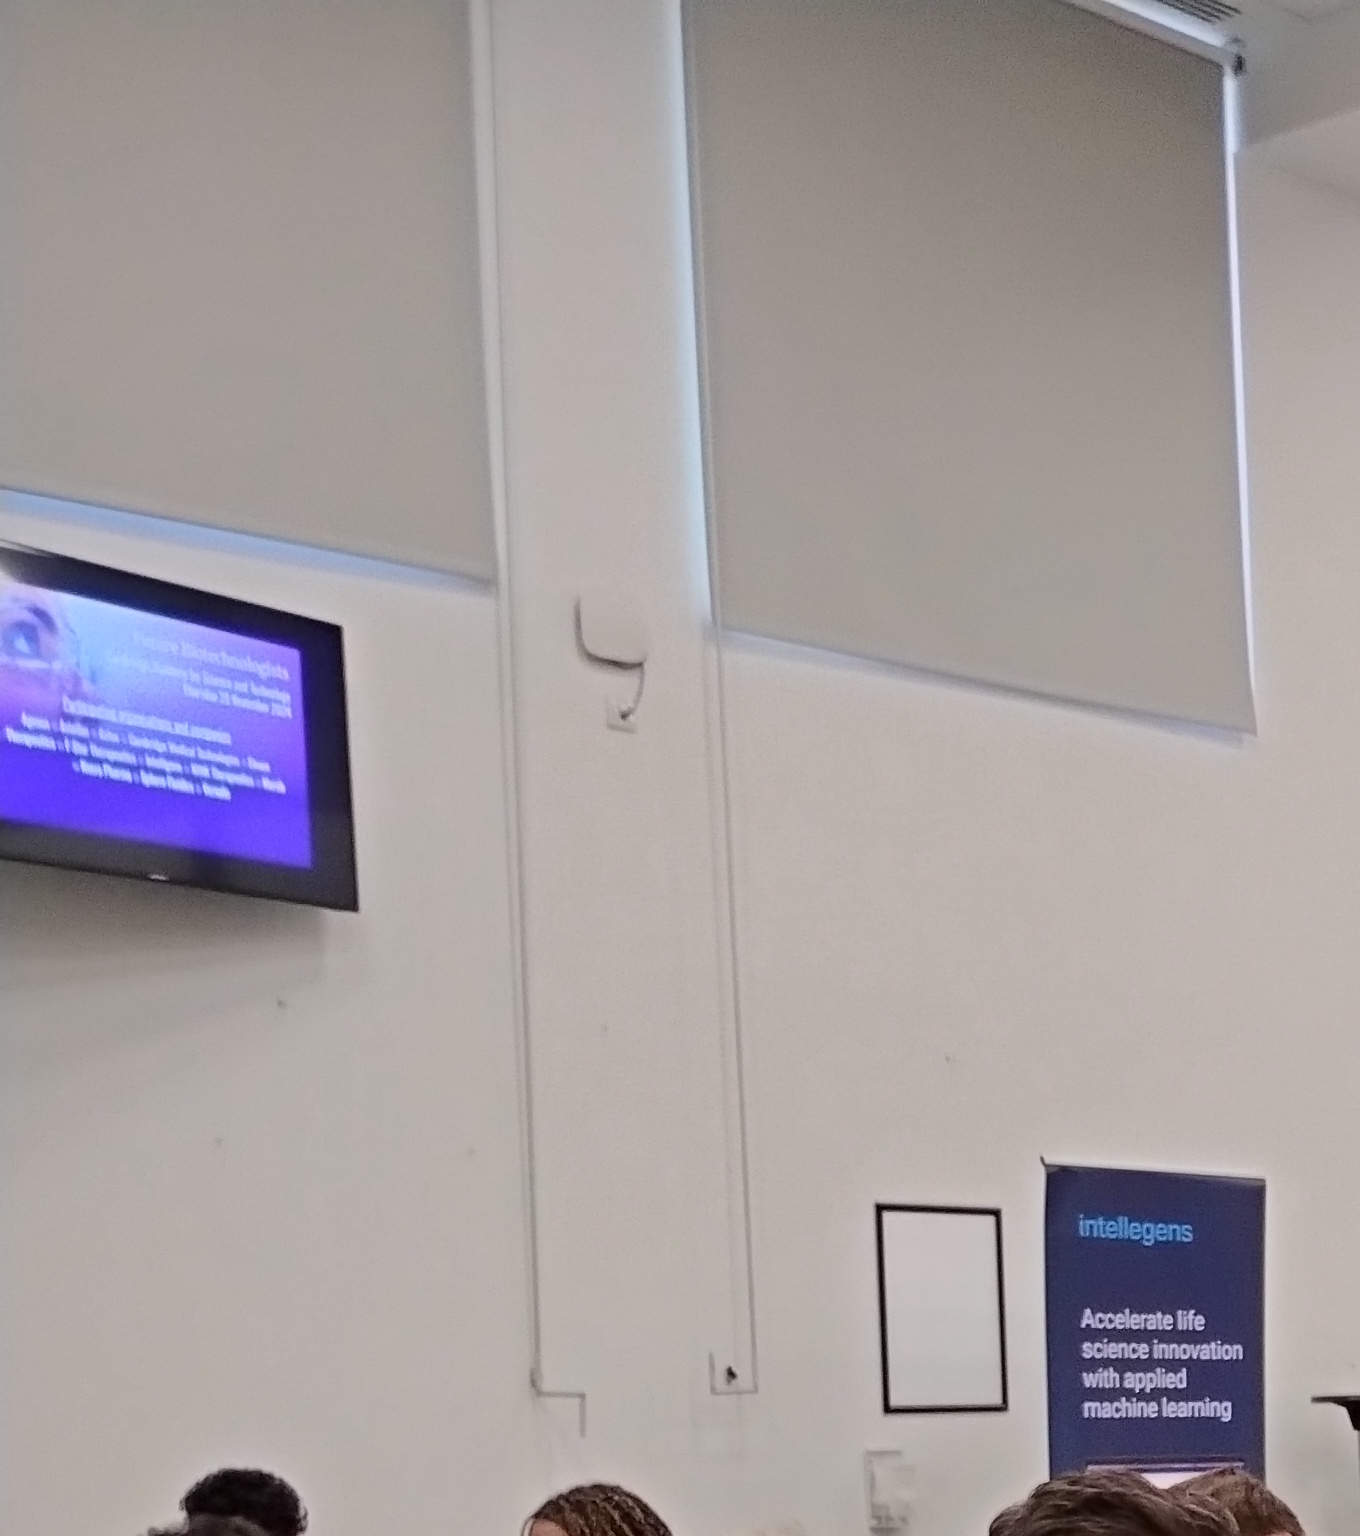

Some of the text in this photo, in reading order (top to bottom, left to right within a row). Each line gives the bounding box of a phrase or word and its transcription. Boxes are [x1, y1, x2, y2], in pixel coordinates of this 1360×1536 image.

[1078, 1214, 1194, 1246] intellegens
[1080, 1307, 1206, 1331] Accelerate life
[1081, 1338, 1244, 1360] science innovation
[1082, 1366, 1187, 1393] with applied
[1082, 1396, 1233, 1422] machine learning
